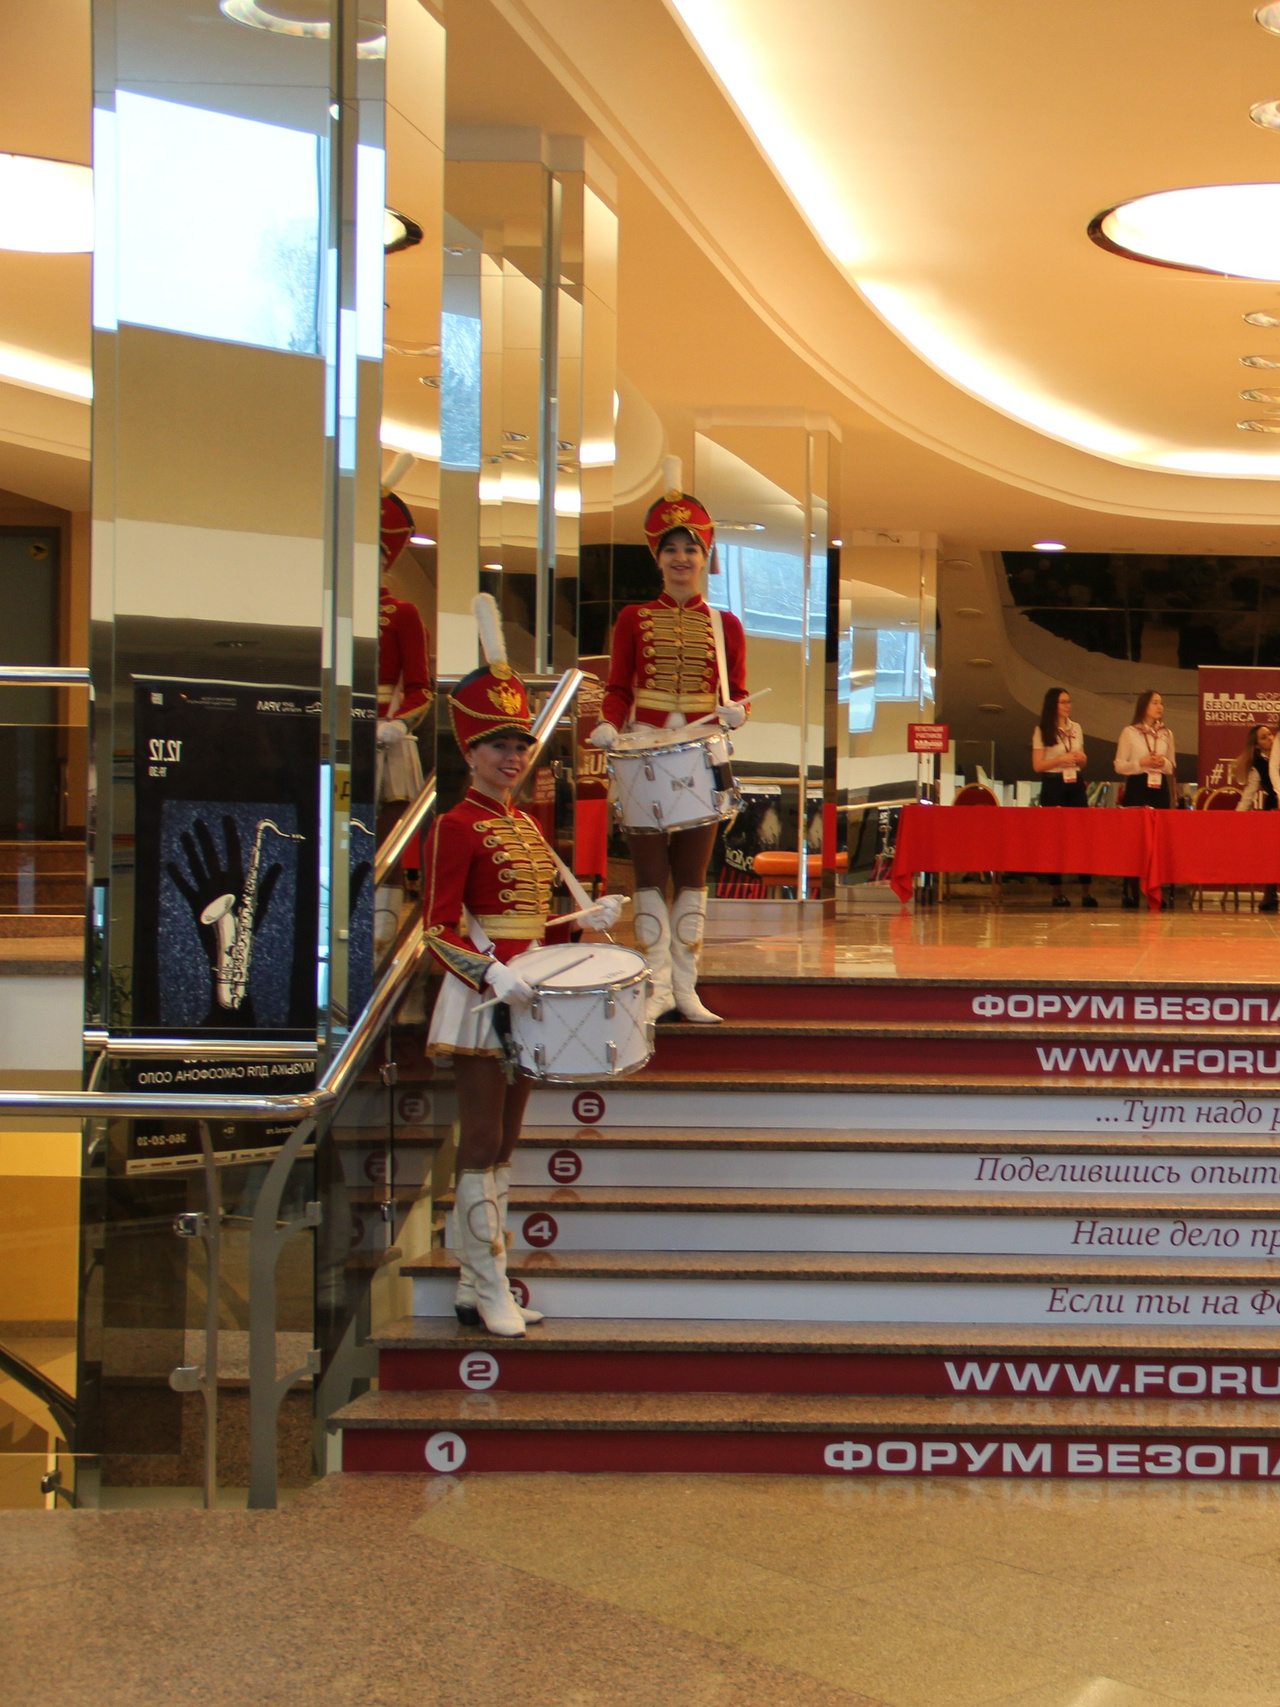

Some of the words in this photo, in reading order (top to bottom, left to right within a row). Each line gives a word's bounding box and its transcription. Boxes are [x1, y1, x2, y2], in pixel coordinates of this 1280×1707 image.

[1205, 711, 1255, 722] БИЗНЕСА
[972, 994, 1125, 1020] ФОРУМ
[578, 1098, 600, 1117] 6
[1095, 1099, 1186, 1130] ...Тут
[1195, 1100, 1263, 1125] надо
[554, 1157, 577, 1177] 5
[974, 1156, 1182, 1184] Поделившись
[528, 1220, 552, 1240] 4
[1070, 1220, 1161, 1247] Наше
[1169, 1221, 1240, 1248] дело
[1046, 1287, 1124, 1314] Если
[1135, 1294, 1190, 1316] ты
[1201, 1295, 1240, 1316] на
[467, 1360, 491, 1382] 2
[437, 1441, 454, 1462] 1
[822, 1440, 1052, 1473] ФОРУМ
